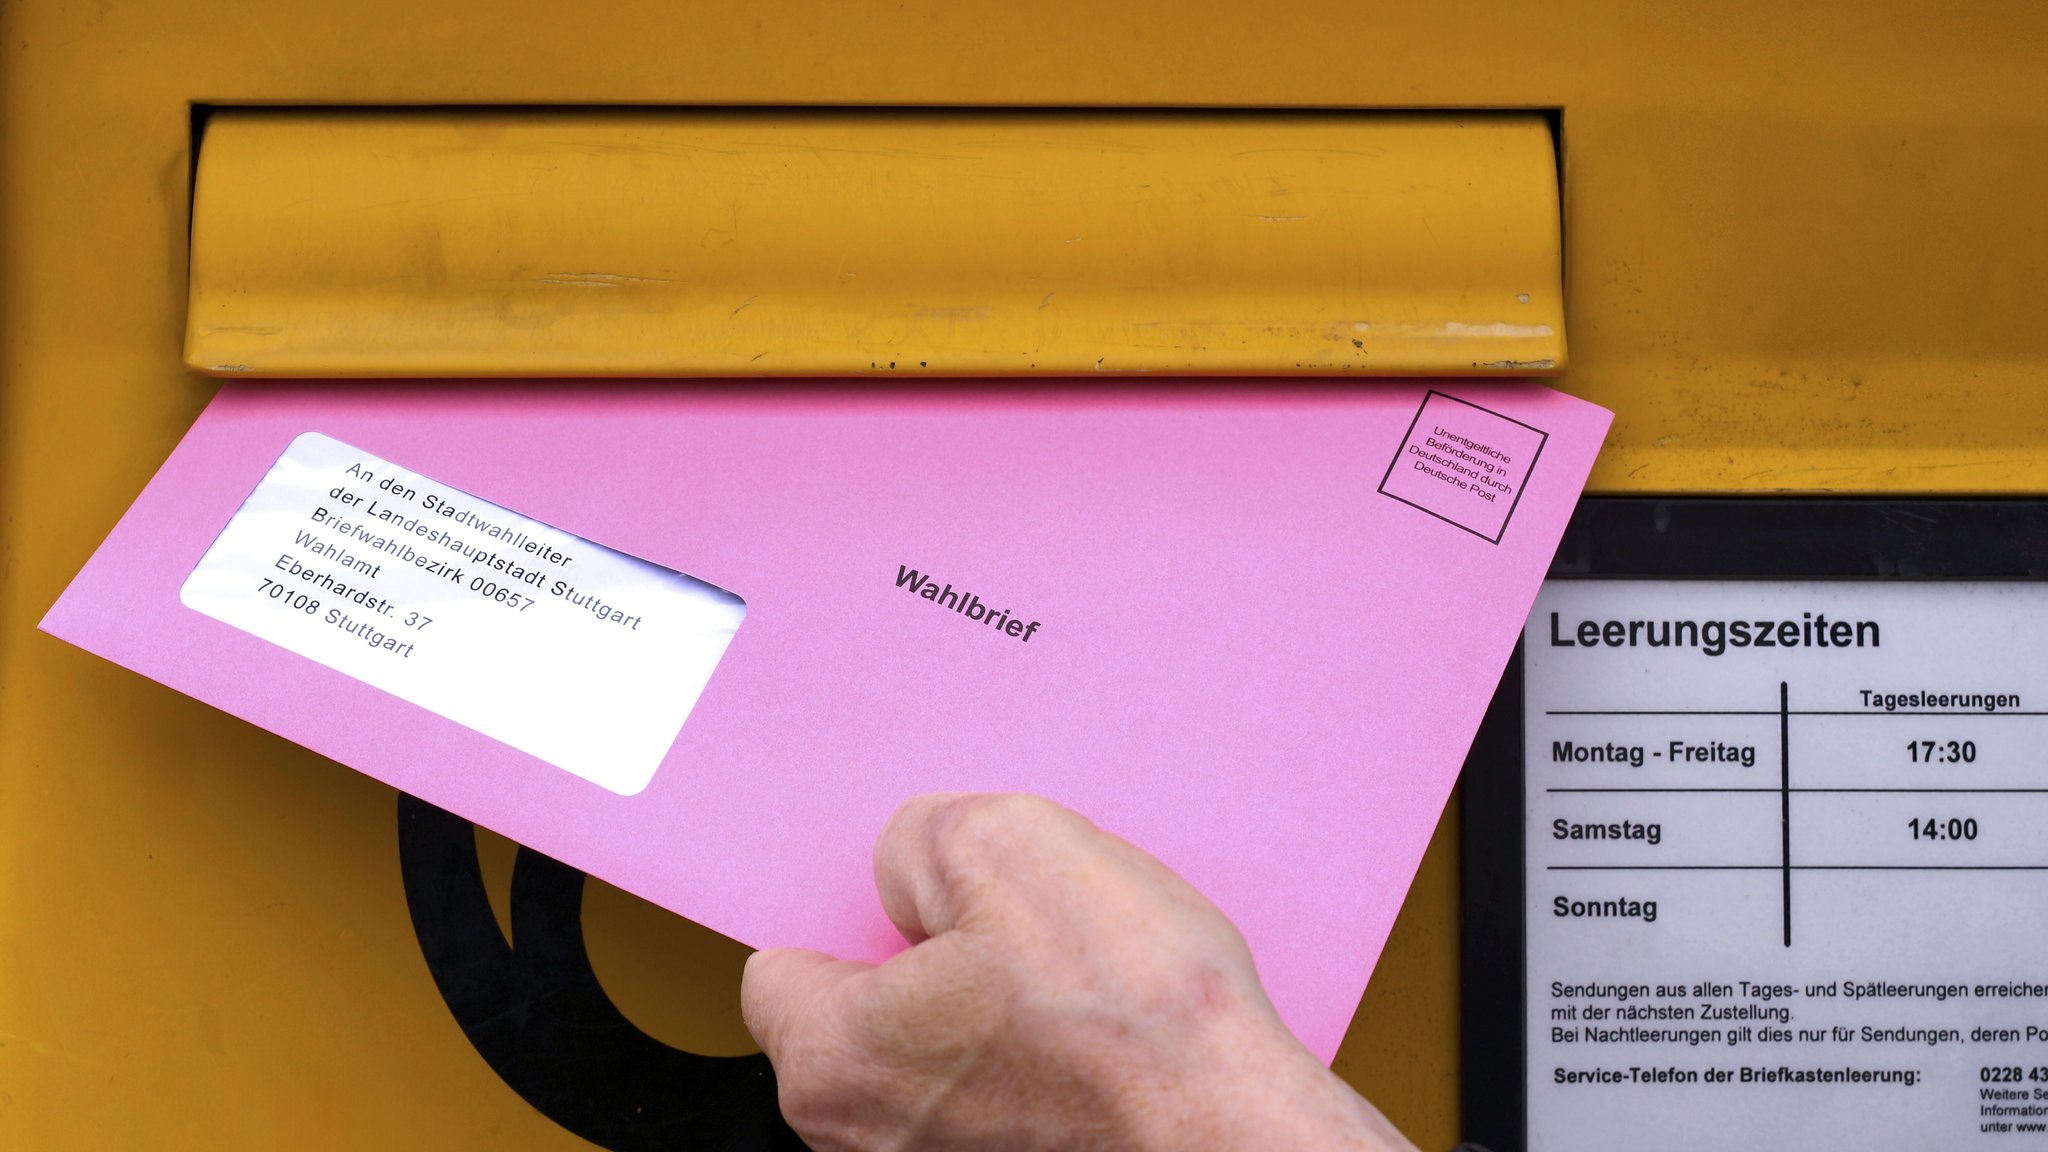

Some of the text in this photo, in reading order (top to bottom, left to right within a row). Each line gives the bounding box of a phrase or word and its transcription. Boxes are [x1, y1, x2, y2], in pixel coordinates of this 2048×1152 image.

[1425, 437, 1507, 477] Beförderung in
[1433, 425, 1511, 464] Unentgeltliche
[1408, 444, 1512, 495] Deutschland durch
[1413, 460, 1496, 503] Deutsche Post
[345, 462, 573, 567] An den Stadtwahlleiter
[295, 530, 382, 579] Wahlamt
[311, 506, 535, 612] Briefwahlbezirk 00657
[329, 486, 642, 631] der Landeshauptstadt Stuttgart
[274, 554, 433, 631] Eberhardstr. 37
[895, 564, 1041, 643] Wahlbrief
[257, 577, 415, 658] 70108 Stuttgart
[1550, 611, 1881, 657] Leerungszeiten
[1859, 690, 2020, 711] Tagesleerungen
[1552, 741, 1645, 768] Montag
[1669, 741, 1756, 768] Freitag
[1906, 740, 1977, 764] 17:30
[1552, 818, 1662, 846] Samstag
[1908, 817, 1978, 841] 14:00
[1552, 895, 1658, 923] Sonntag
[1550, 981, 1650, 1002] Sendungen
[1655, 985, 1688, 998] aus
[1692, 981, 1734, 998] allen
[1738, 981, 1800, 1002] Tages-
[1805, 981, 1837, 998] und
[1842, 981, 1969, 1002] Spätleerungen
[1550, 1004, 1795, 1024] mit der nächsten Zustellung.
[1551, 1026, 1580, 1043] Bei
[1584, 1026, 1722, 1046] Nachtleerungen
[1726, 1026, 1753, 1046] gilt
[1757, 1026, 1794, 1043] dies
[1798, 1030, 1828, 1043] nur
[1831, 1026, 1856, 1043] für
[1860, 1026, 1966, 1046] Sendungen,
[1970, 1026, 2021, 1043] deren
[1553, 1067, 1922, 1087] Service-Telefon der Briefkastenleerung:
[1979, 1066, 2024, 1084] 0228
[1979, 1088, 2030, 1102] Weitere
[1979, 1121, 2013, 1134] unter
